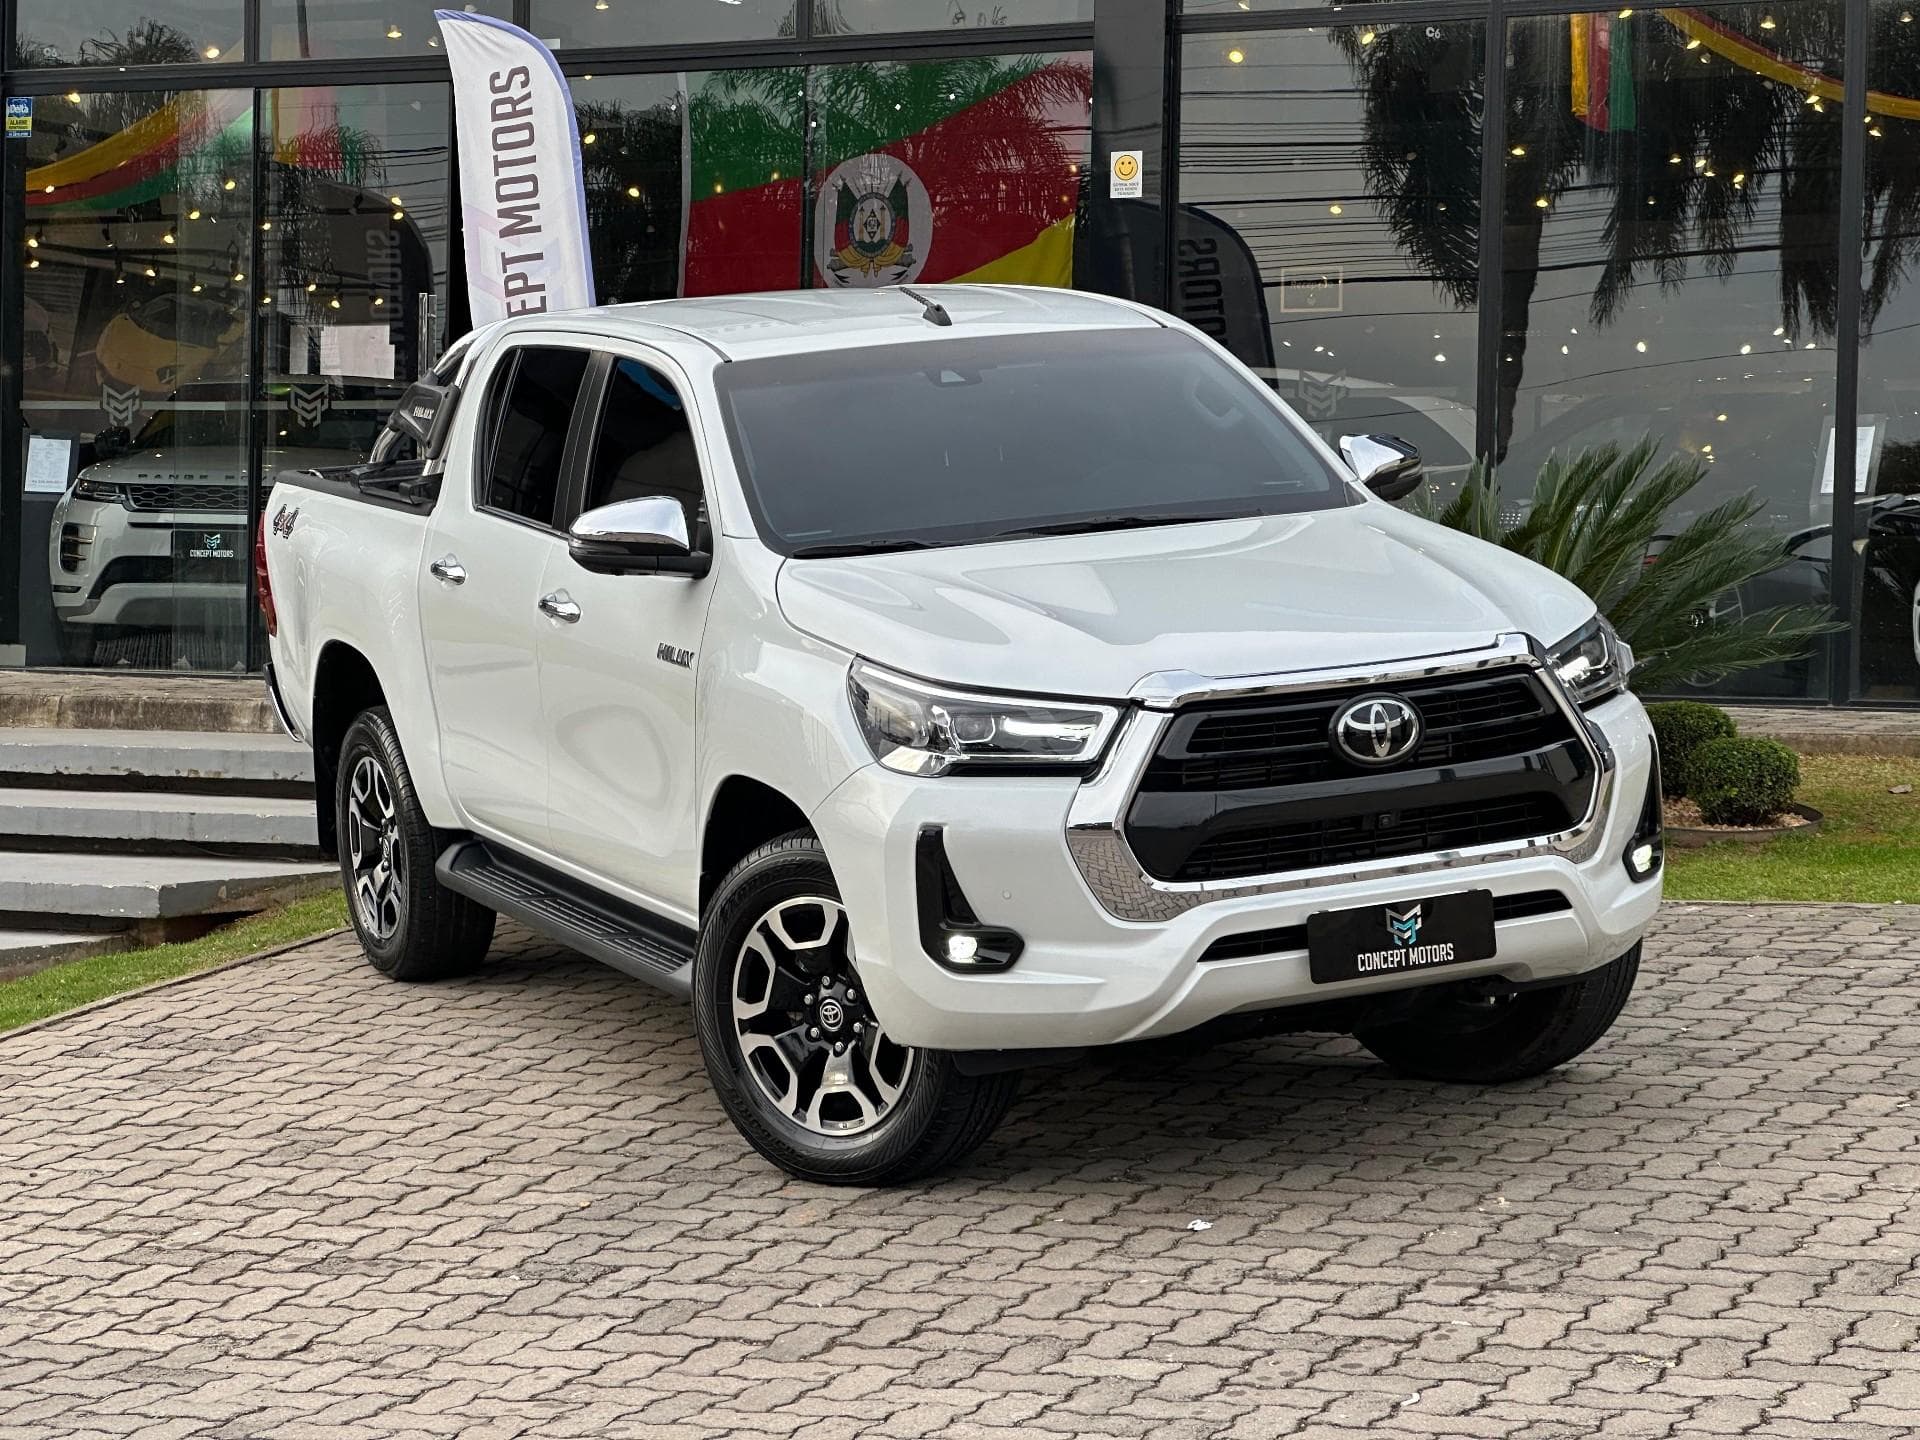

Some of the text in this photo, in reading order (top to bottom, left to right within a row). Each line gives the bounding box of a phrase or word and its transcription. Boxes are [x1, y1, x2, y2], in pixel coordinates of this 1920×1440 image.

[489, 66, 542, 238] MOTORS
[189, 549, 234, 558] CONCEPT MOTORS
[1357, 942, 1455, 972] CONCEPT MOTORS
